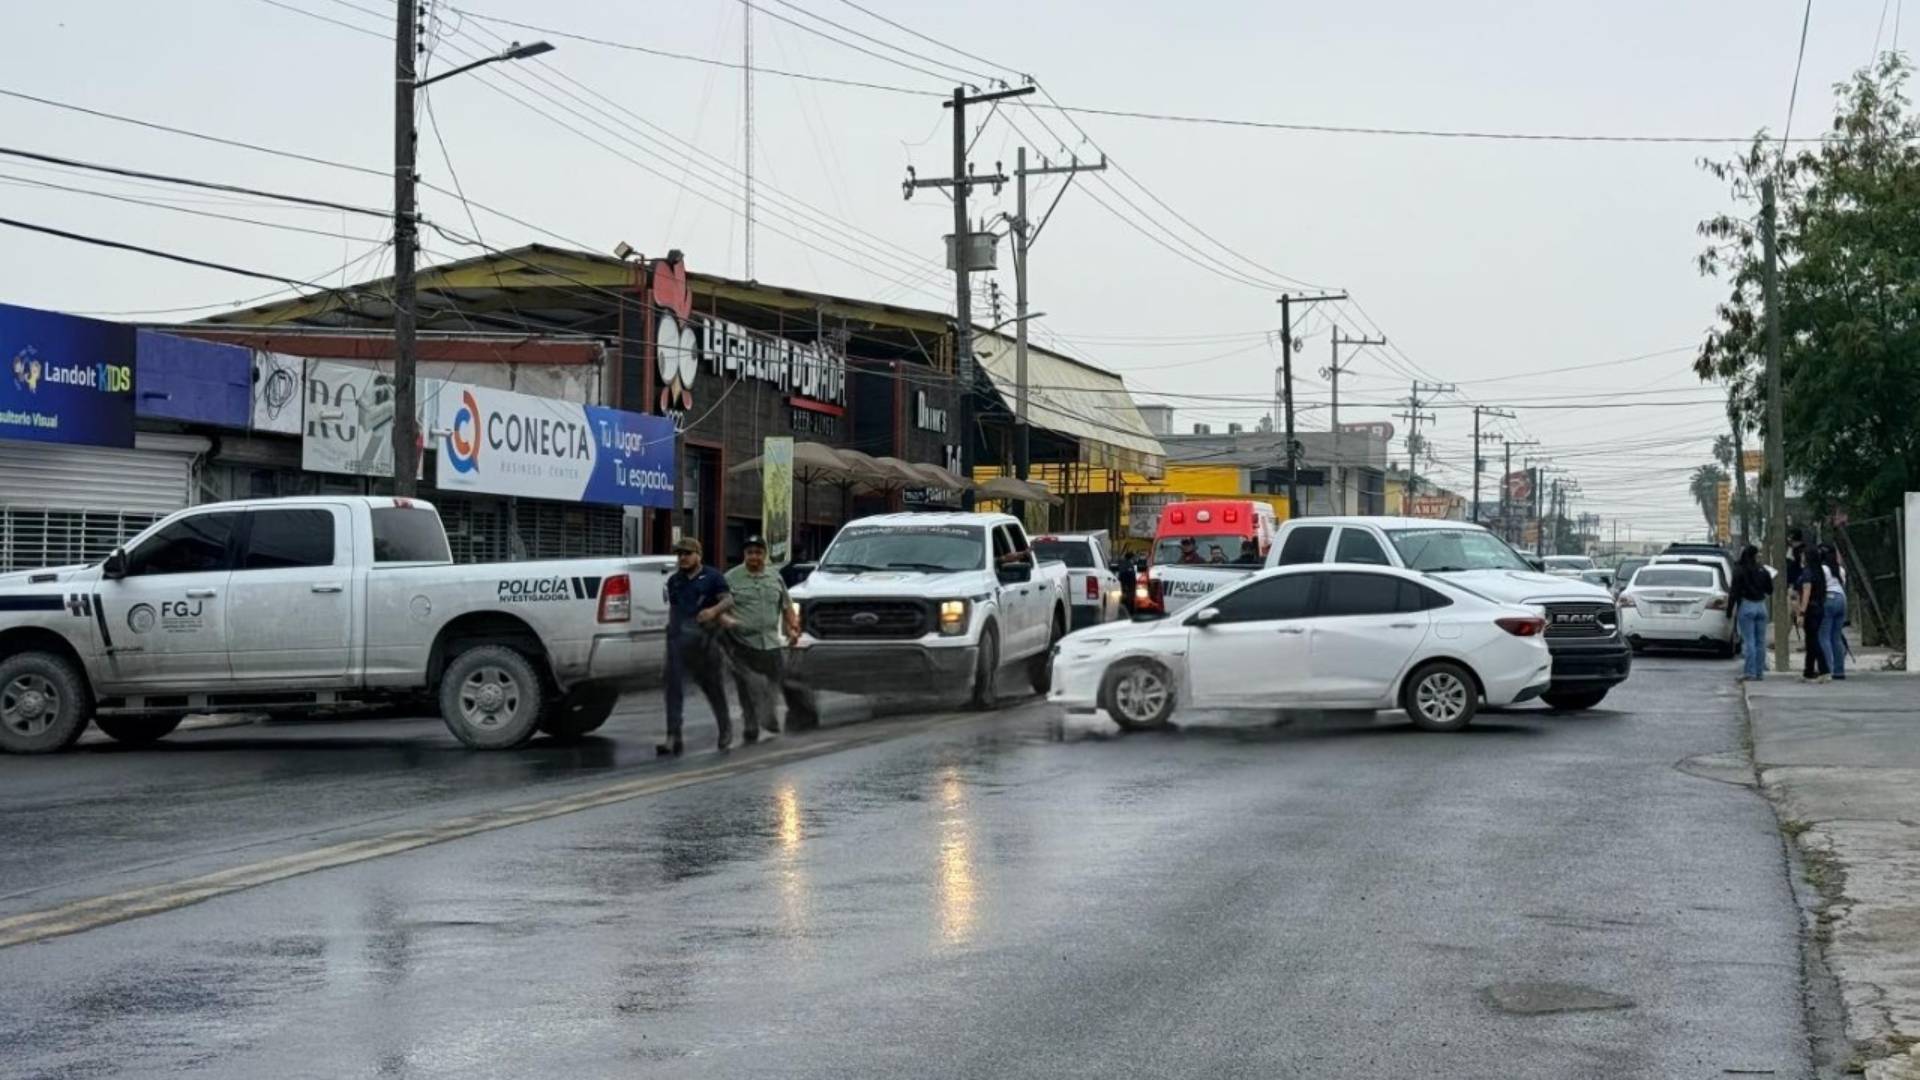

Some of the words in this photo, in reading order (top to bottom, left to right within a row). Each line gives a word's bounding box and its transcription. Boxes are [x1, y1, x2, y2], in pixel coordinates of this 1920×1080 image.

[44, 361, 97, 387] Landolt
[96, 363, 131, 392] KIDS
[32, 412, 58, 428] Visual
[488, 411, 590, 460] CONECTA
[599, 419, 612, 449] Tu
[614, 422, 645, 458] lugar,
[613, 458, 627, 487] Tu
[497, 575, 569, 594] POLICÍA
[161, 600, 203, 617] FGJ
[1556, 613, 1595, 624] RAM
